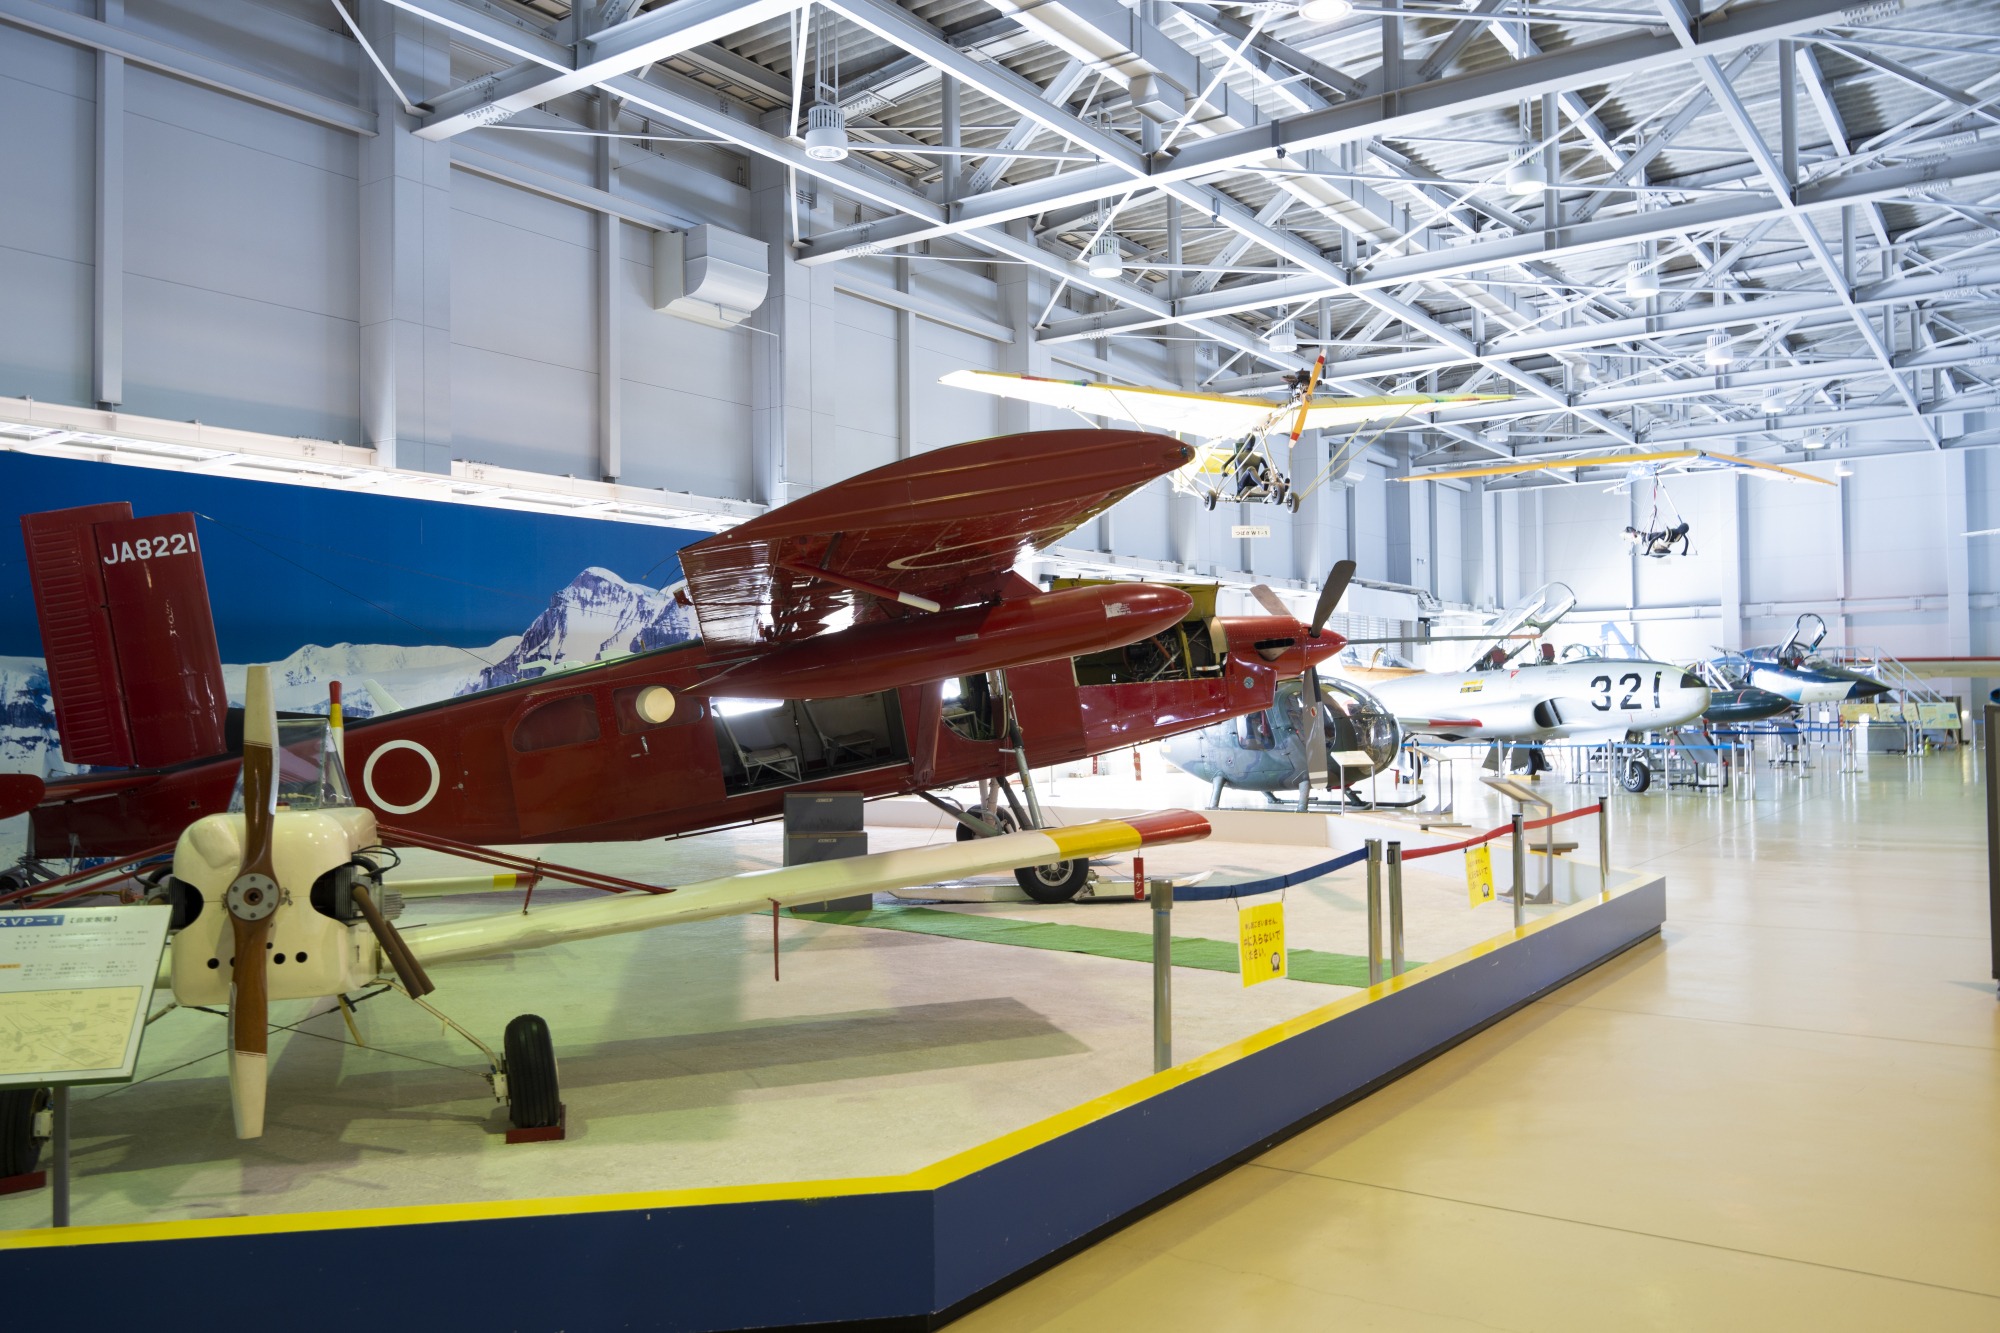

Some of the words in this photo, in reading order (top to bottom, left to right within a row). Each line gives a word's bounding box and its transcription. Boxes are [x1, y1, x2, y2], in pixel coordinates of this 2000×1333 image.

[103, 532, 197, 565] JA8221
[1590, 671, 1662, 711] 321
[1135, 872, 1143, 894] キケン
